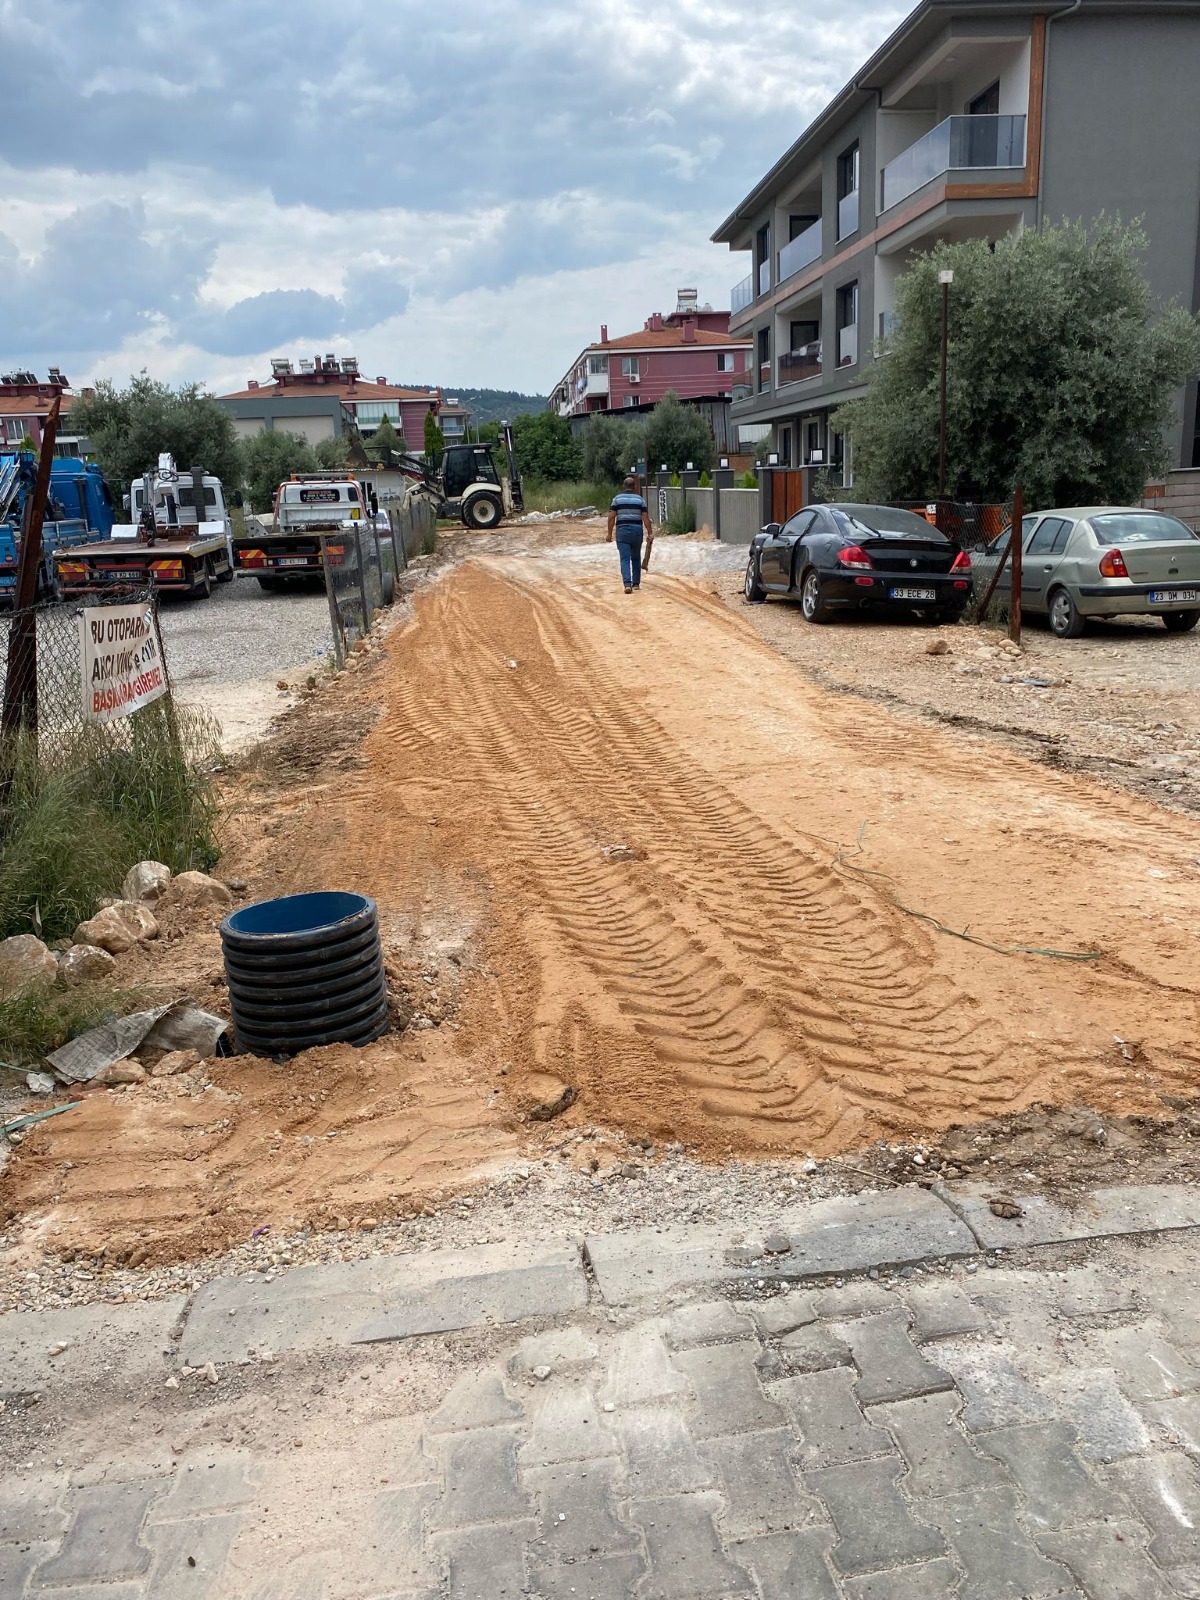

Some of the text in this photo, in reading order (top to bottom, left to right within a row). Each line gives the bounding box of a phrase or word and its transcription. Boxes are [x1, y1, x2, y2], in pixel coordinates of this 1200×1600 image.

[894, 588, 935, 599] 33 ECE 28
[1155, 592, 1164, 600] 23
[91, 620, 105, 644] BU
